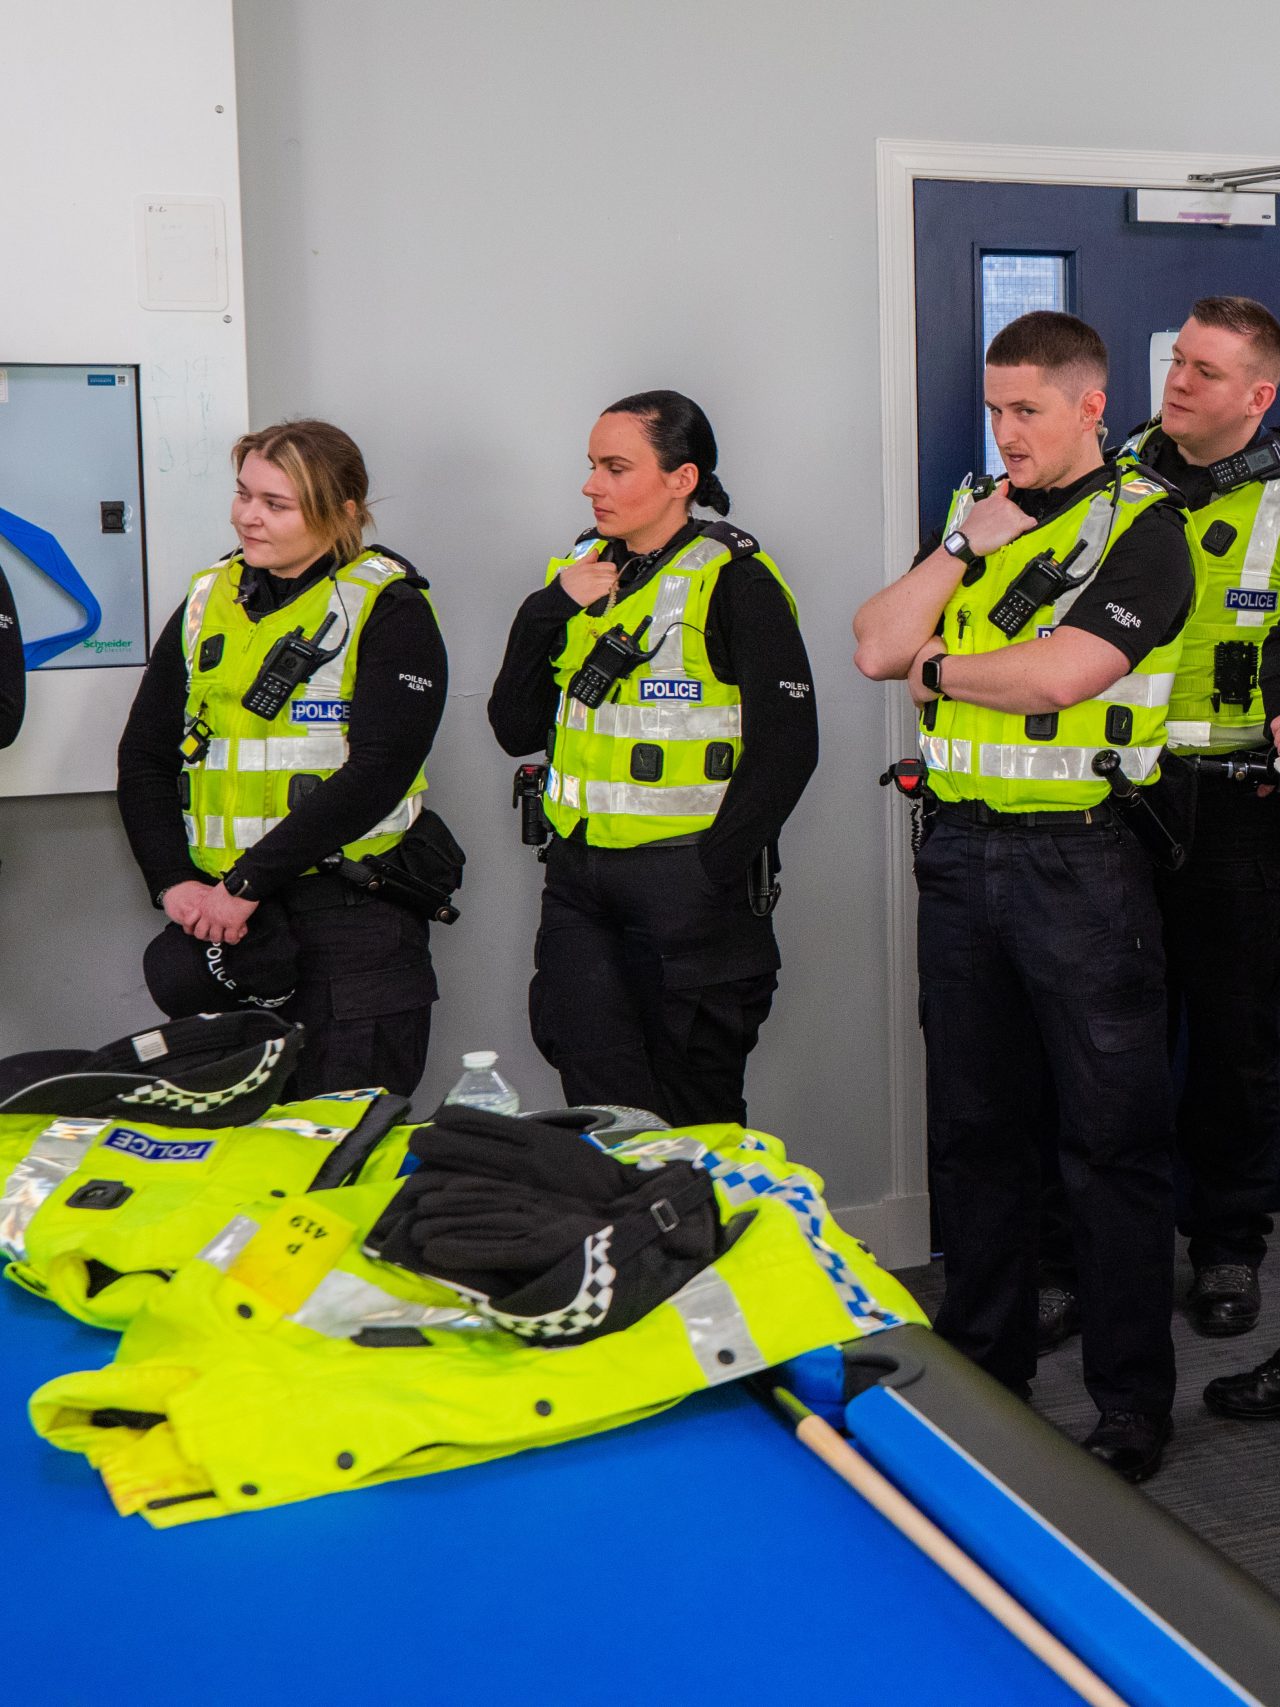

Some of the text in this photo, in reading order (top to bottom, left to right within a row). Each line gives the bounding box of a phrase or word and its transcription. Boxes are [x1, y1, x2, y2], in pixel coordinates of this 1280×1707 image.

[737, 539, 754, 549] 419
[1229, 591, 1275, 608] POLICE
[1105, 602, 1142, 629] POILEAS
[1111, 613, 1131, 629] ALBA
[83, 640, 133, 648] Schneider
[399, 673, 433, 688] POILEAS
[407, 683, 425, 692] ALBA
[779, 680, 810, 692] POILEAS
[643, 682, 699, 698] POLICE
[295, 703, 350, 720] POLICE
[111, 1131, 208, 1158] POLICE
[289, 1214, 329, 1240] 419
[285, 1242, 304, 1256] P
